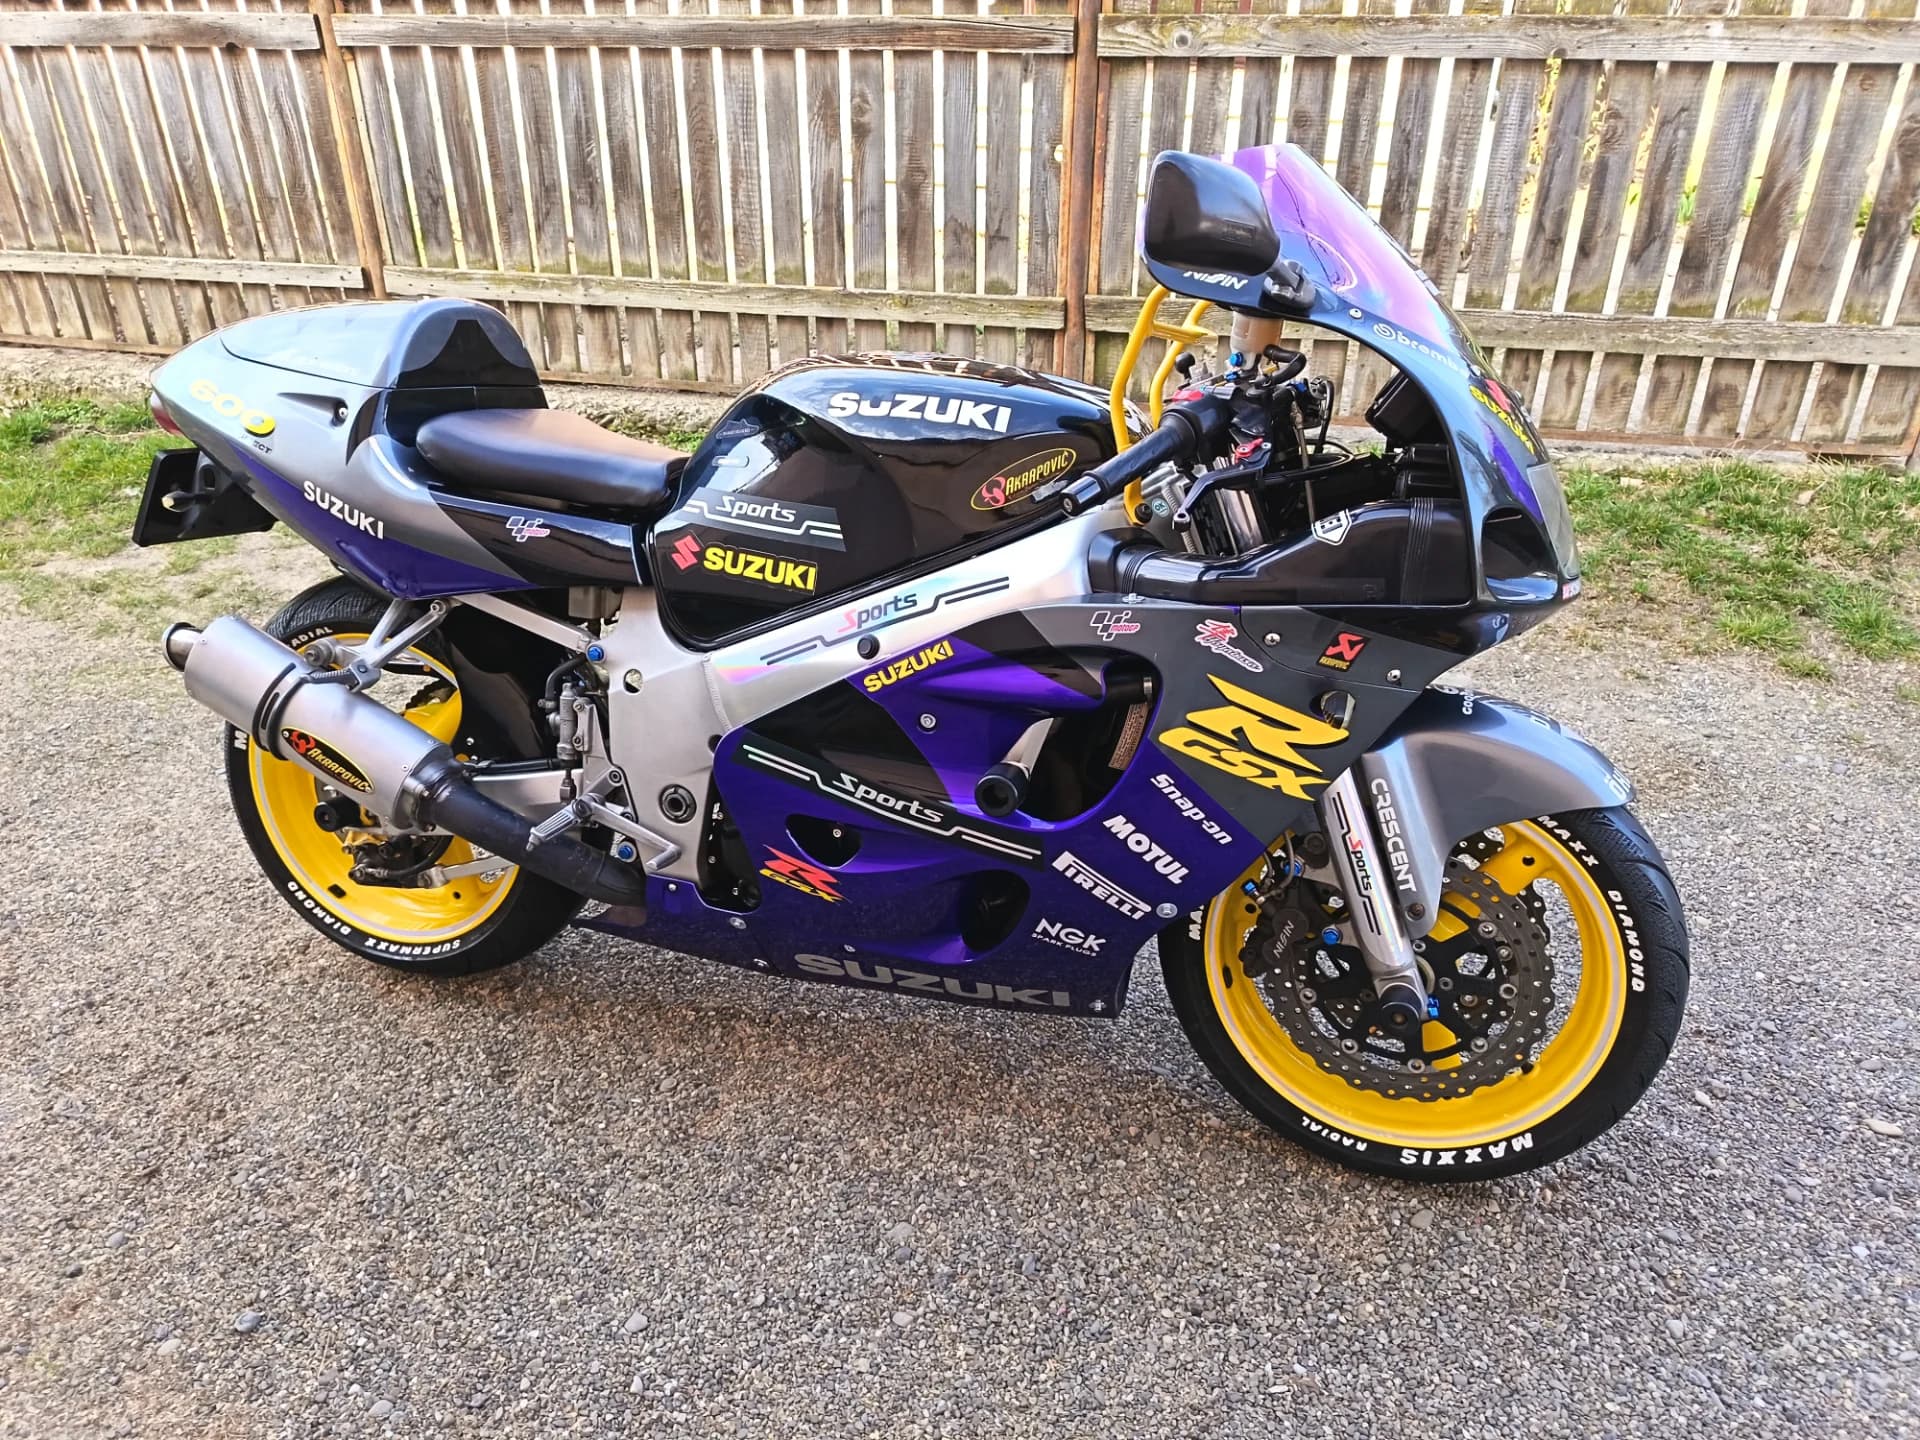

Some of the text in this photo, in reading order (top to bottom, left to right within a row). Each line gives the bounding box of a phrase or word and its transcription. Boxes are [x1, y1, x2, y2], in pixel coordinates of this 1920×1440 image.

[190, 378, 276, 437] 600
[827, 392, 1012, 433] SUZUKI
[303, 480, 384, 540] SUZUKI
[715, 495, 797, 523] Sports
[703, 547, 816, 591] SUZUKI
[288, 626, 333, 648] ADIAL
[836, 593, 918, 632] Sports
[863, 640, 954, 692] SUZUKI
[832, 772, 944, 823] Sports
[1150, 773, 1233, 845] Snap-on
[1103, 814, 1190, 885] MOTUL
[1371, 778, 1417, 892] CRESCENT
[1051, 850, 1152, 920] PIRELLI
[1348, 836, 1373, 891] Sports
[287, 880, 352, 936] DIAMOND
[364, 937, 461, 956] SUPERMAXX
[1034, 917, 1107, 952] NGK
[1607, 889, 1646, 992] DIAMOND
[794, 953, 1071, 1007] SUZUKI
[1301, 1115, 1368, 1152] RADIAL
[1400, 1132, 1534, 1166] MAXXIS
